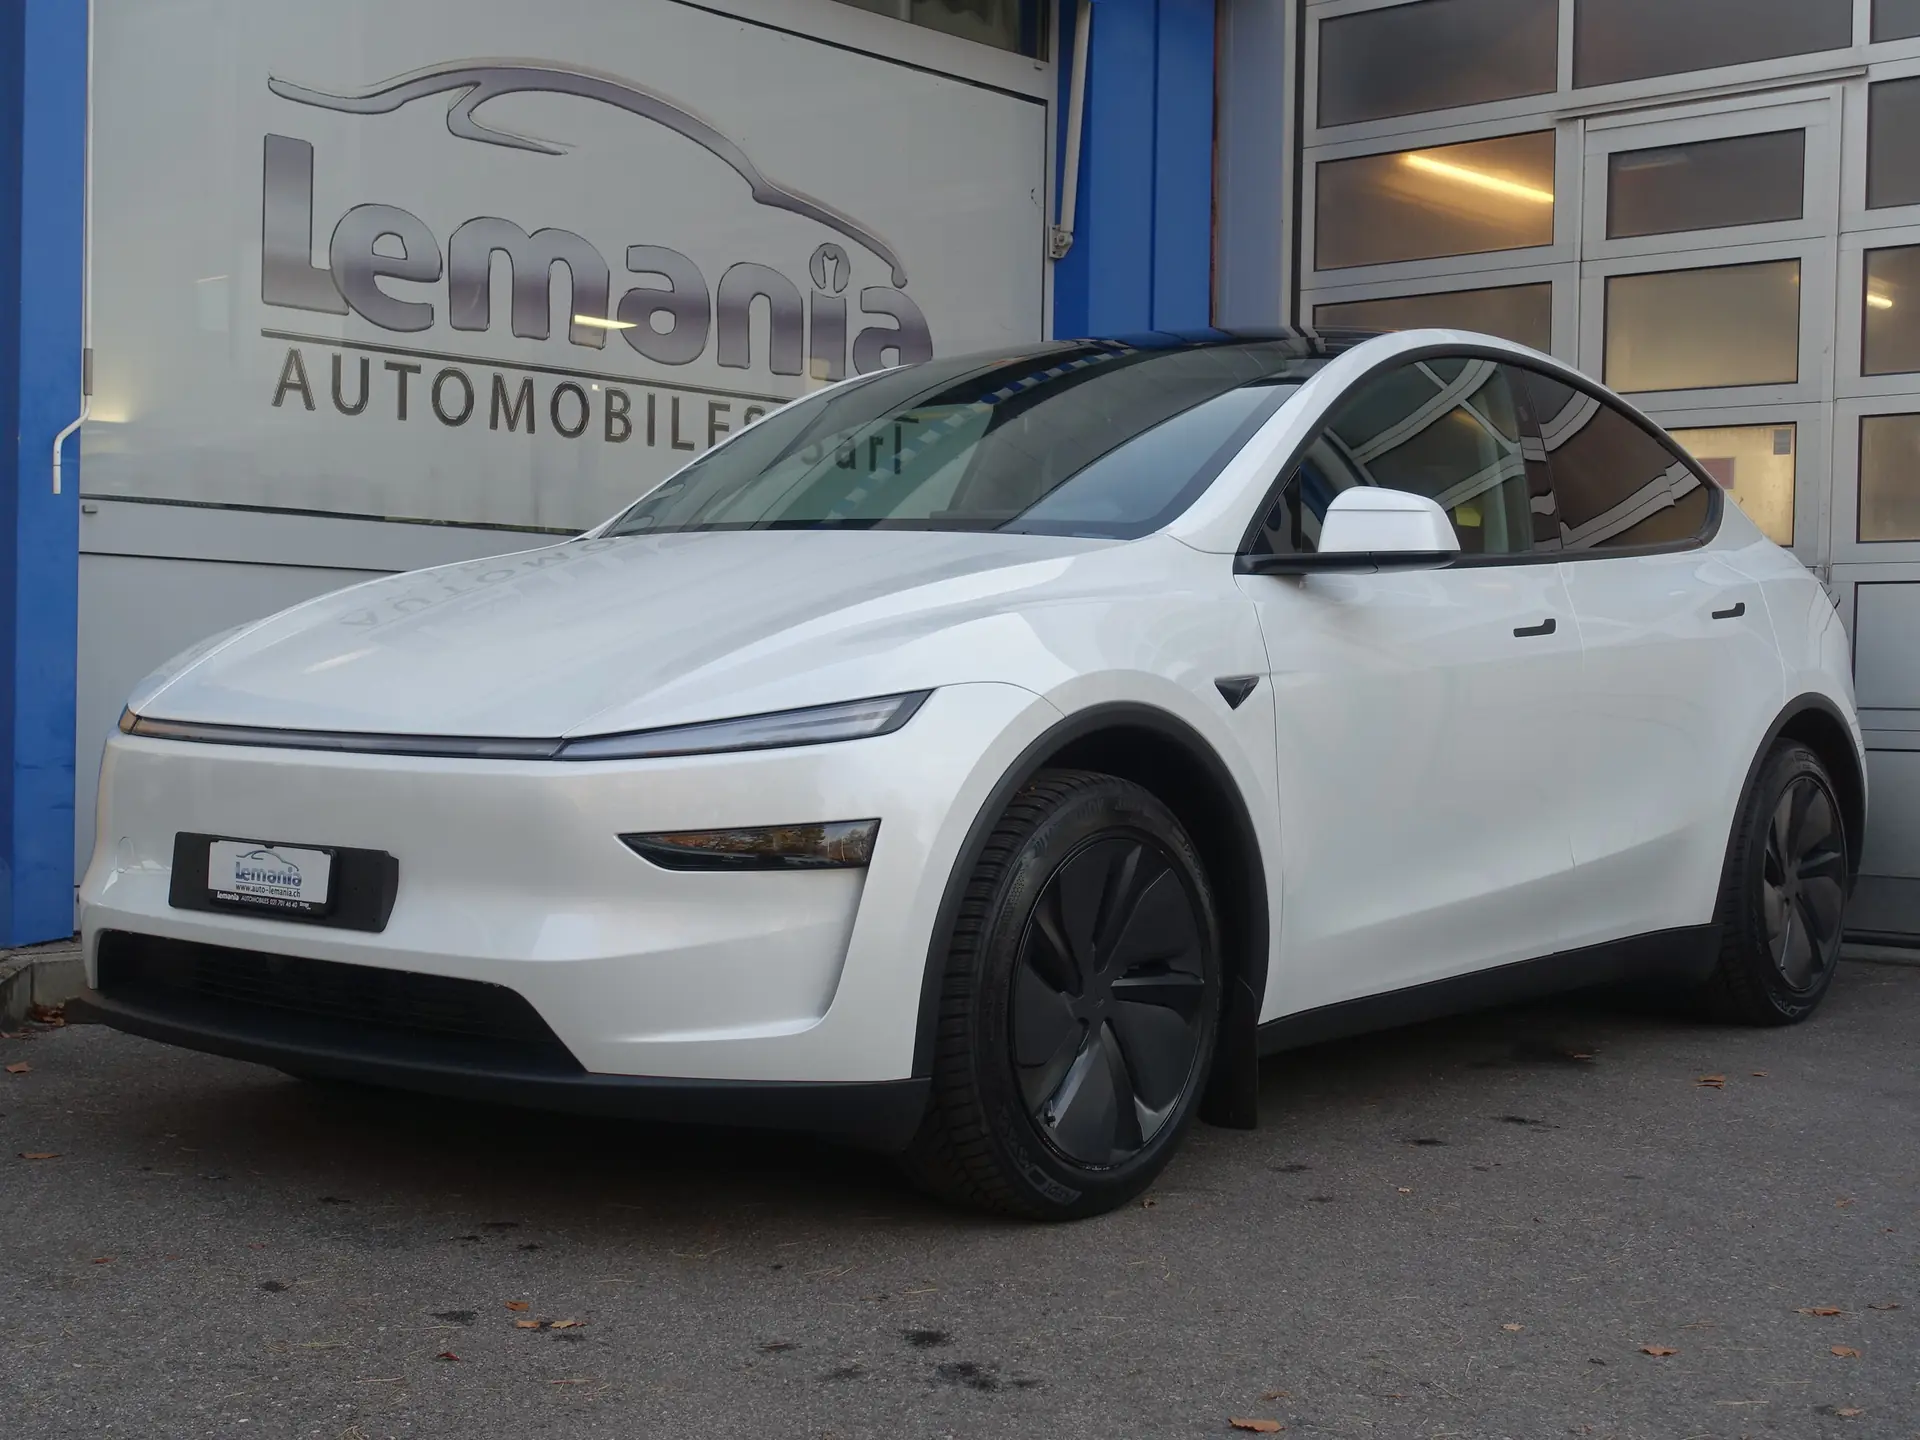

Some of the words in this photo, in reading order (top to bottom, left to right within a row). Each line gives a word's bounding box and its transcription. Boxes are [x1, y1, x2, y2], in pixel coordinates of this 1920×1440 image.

[262, 132, 933, 381] Lemania
[235, 862, 302, 887] Lemania
[235, 884, 301, 898] www.auto-lemania.ch
